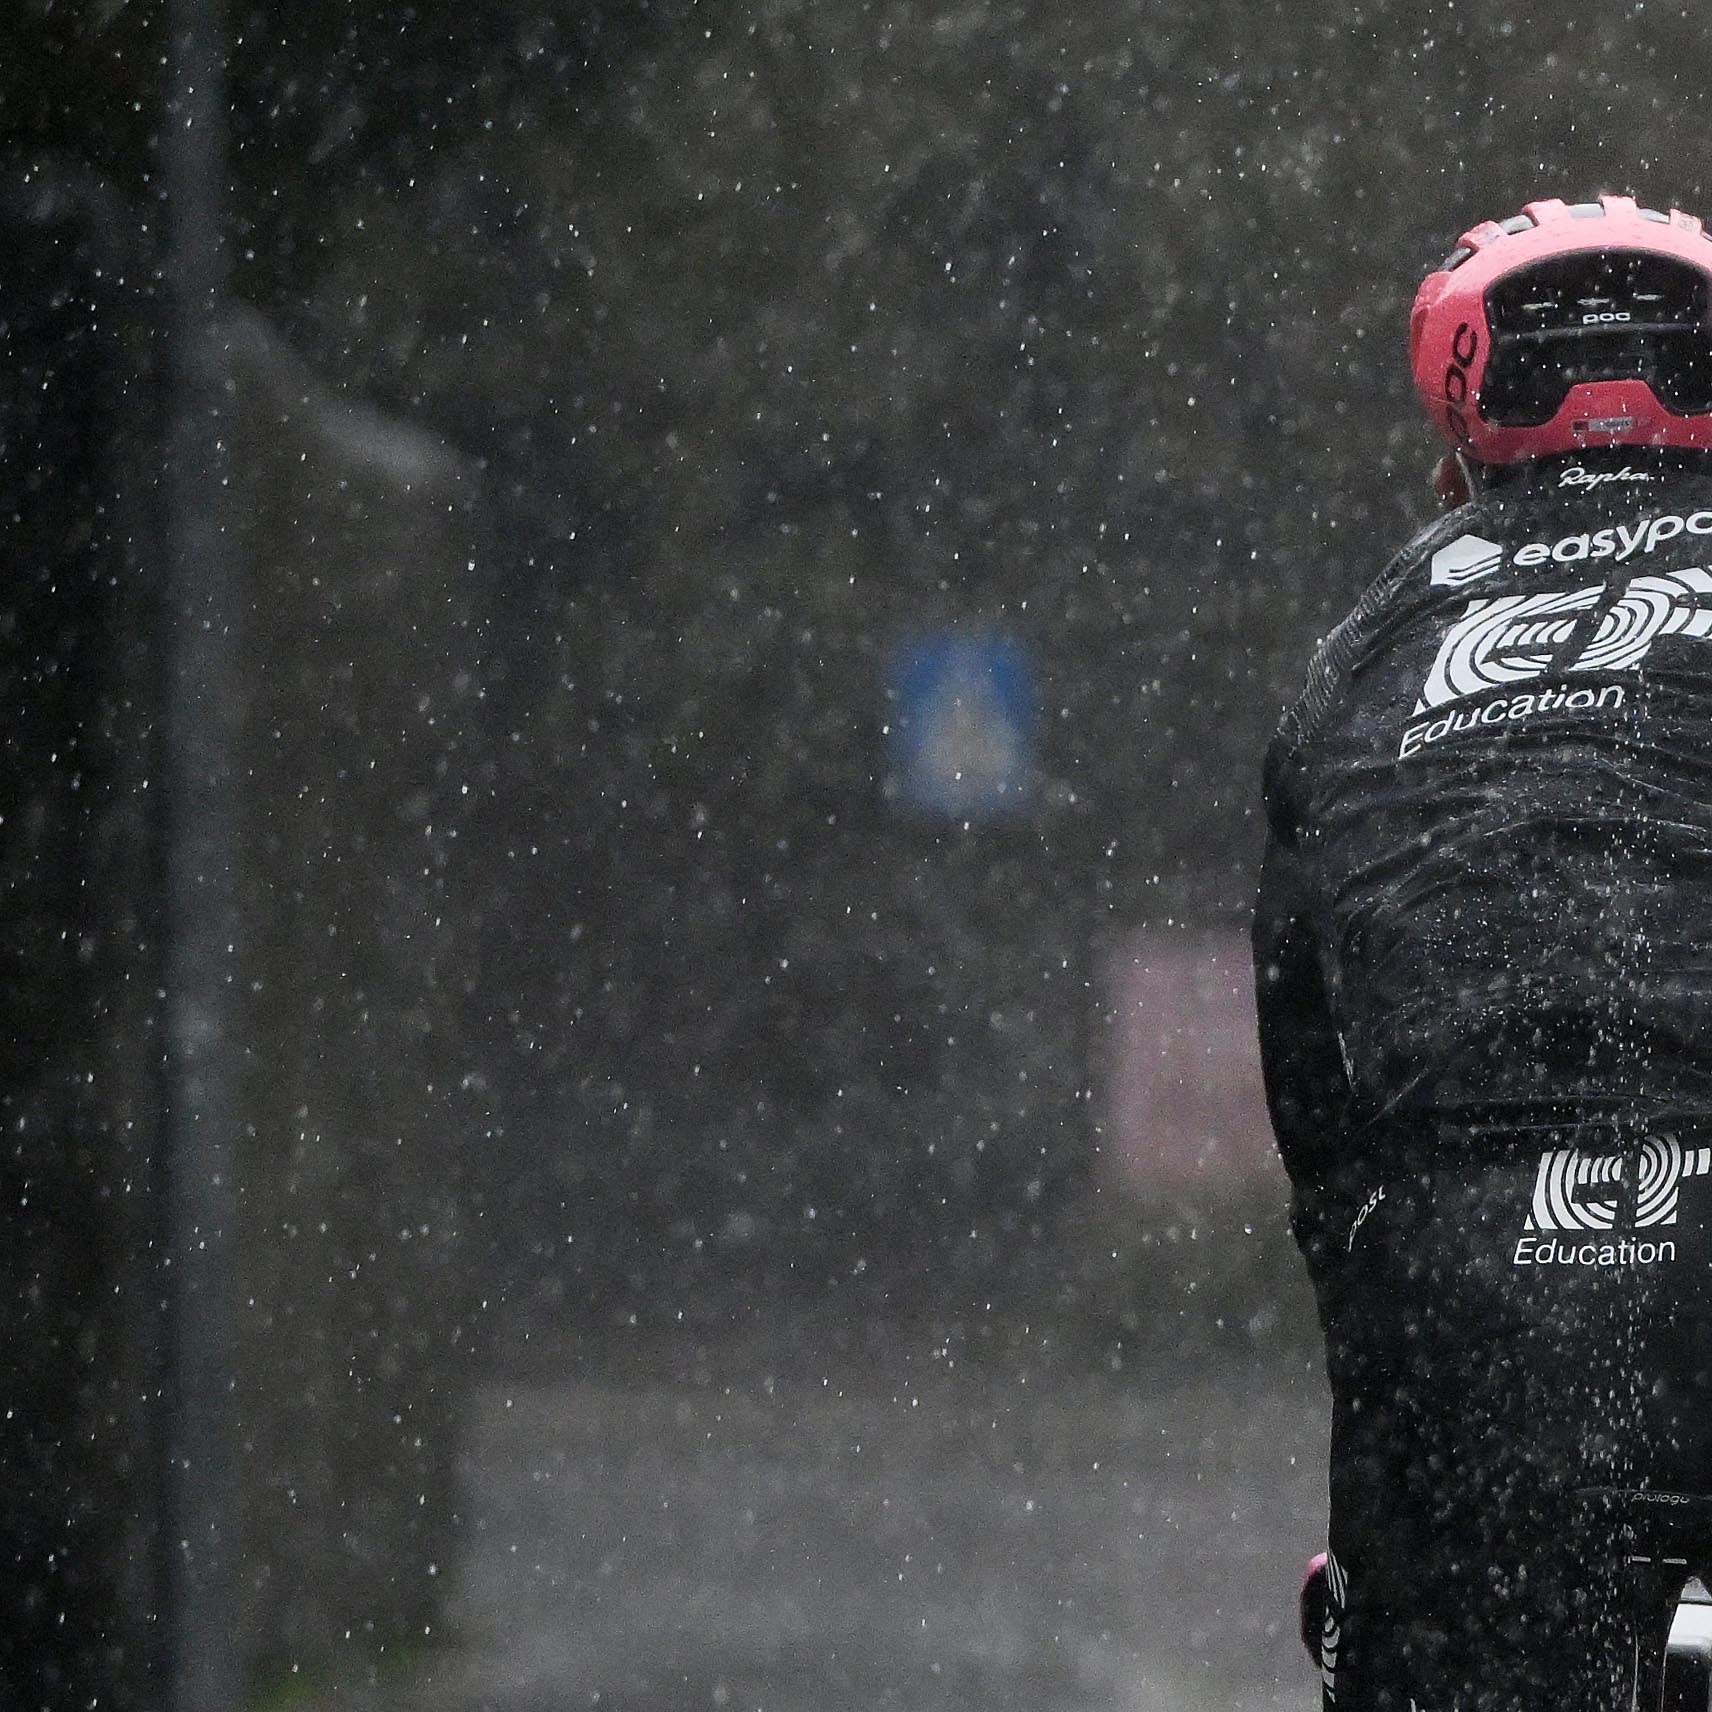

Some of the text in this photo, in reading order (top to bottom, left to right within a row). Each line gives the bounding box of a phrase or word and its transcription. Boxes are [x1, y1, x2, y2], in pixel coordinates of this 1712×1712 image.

[1557, 466, 1651, 491] Rapha
[1397, 681, 1626, 759] Education
[1512, 1236, 1677, 1266] Education
